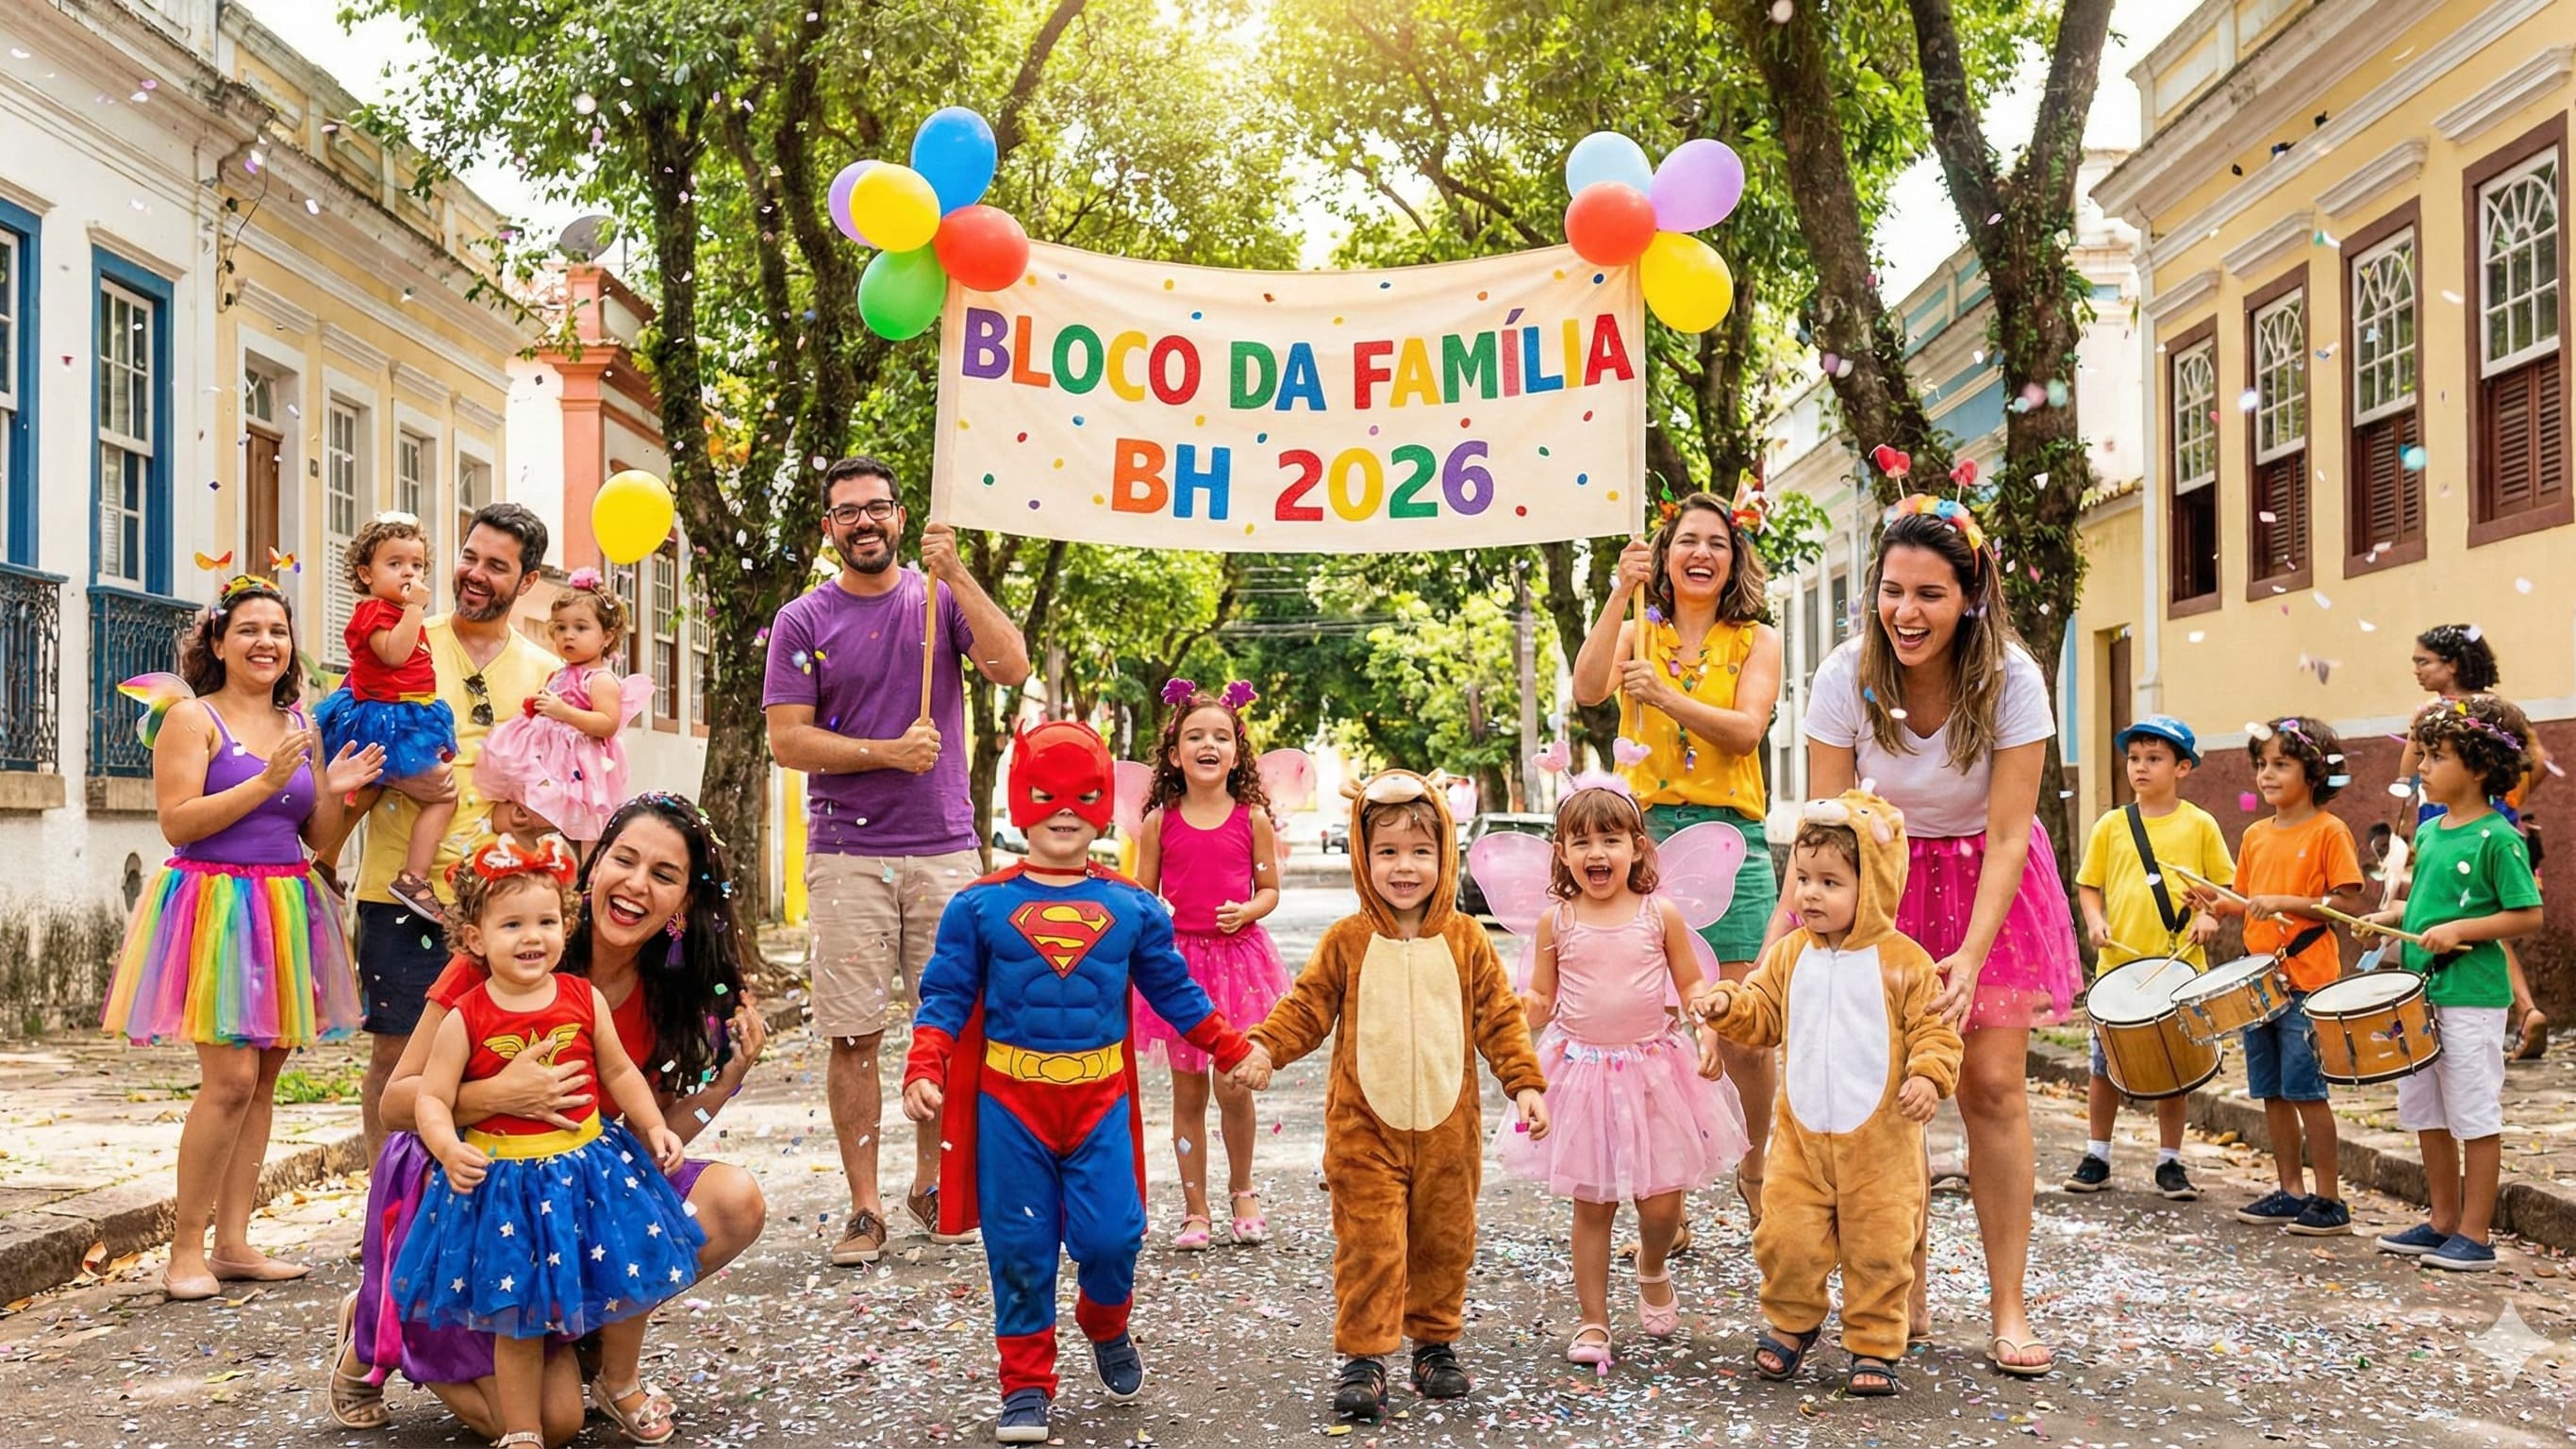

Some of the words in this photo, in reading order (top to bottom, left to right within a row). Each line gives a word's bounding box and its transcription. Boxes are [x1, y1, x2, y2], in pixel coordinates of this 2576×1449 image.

[961, 307, 1202, 406] BLOCO
[1230, 341, 1326, 411] DA
[1354, 308, 1635, 410] FAMÍLIA
[1110, 438, 1231, 521] BH
[1274, 440, 1494, 523] 2026
[1013, 902, 1113, 975] S
